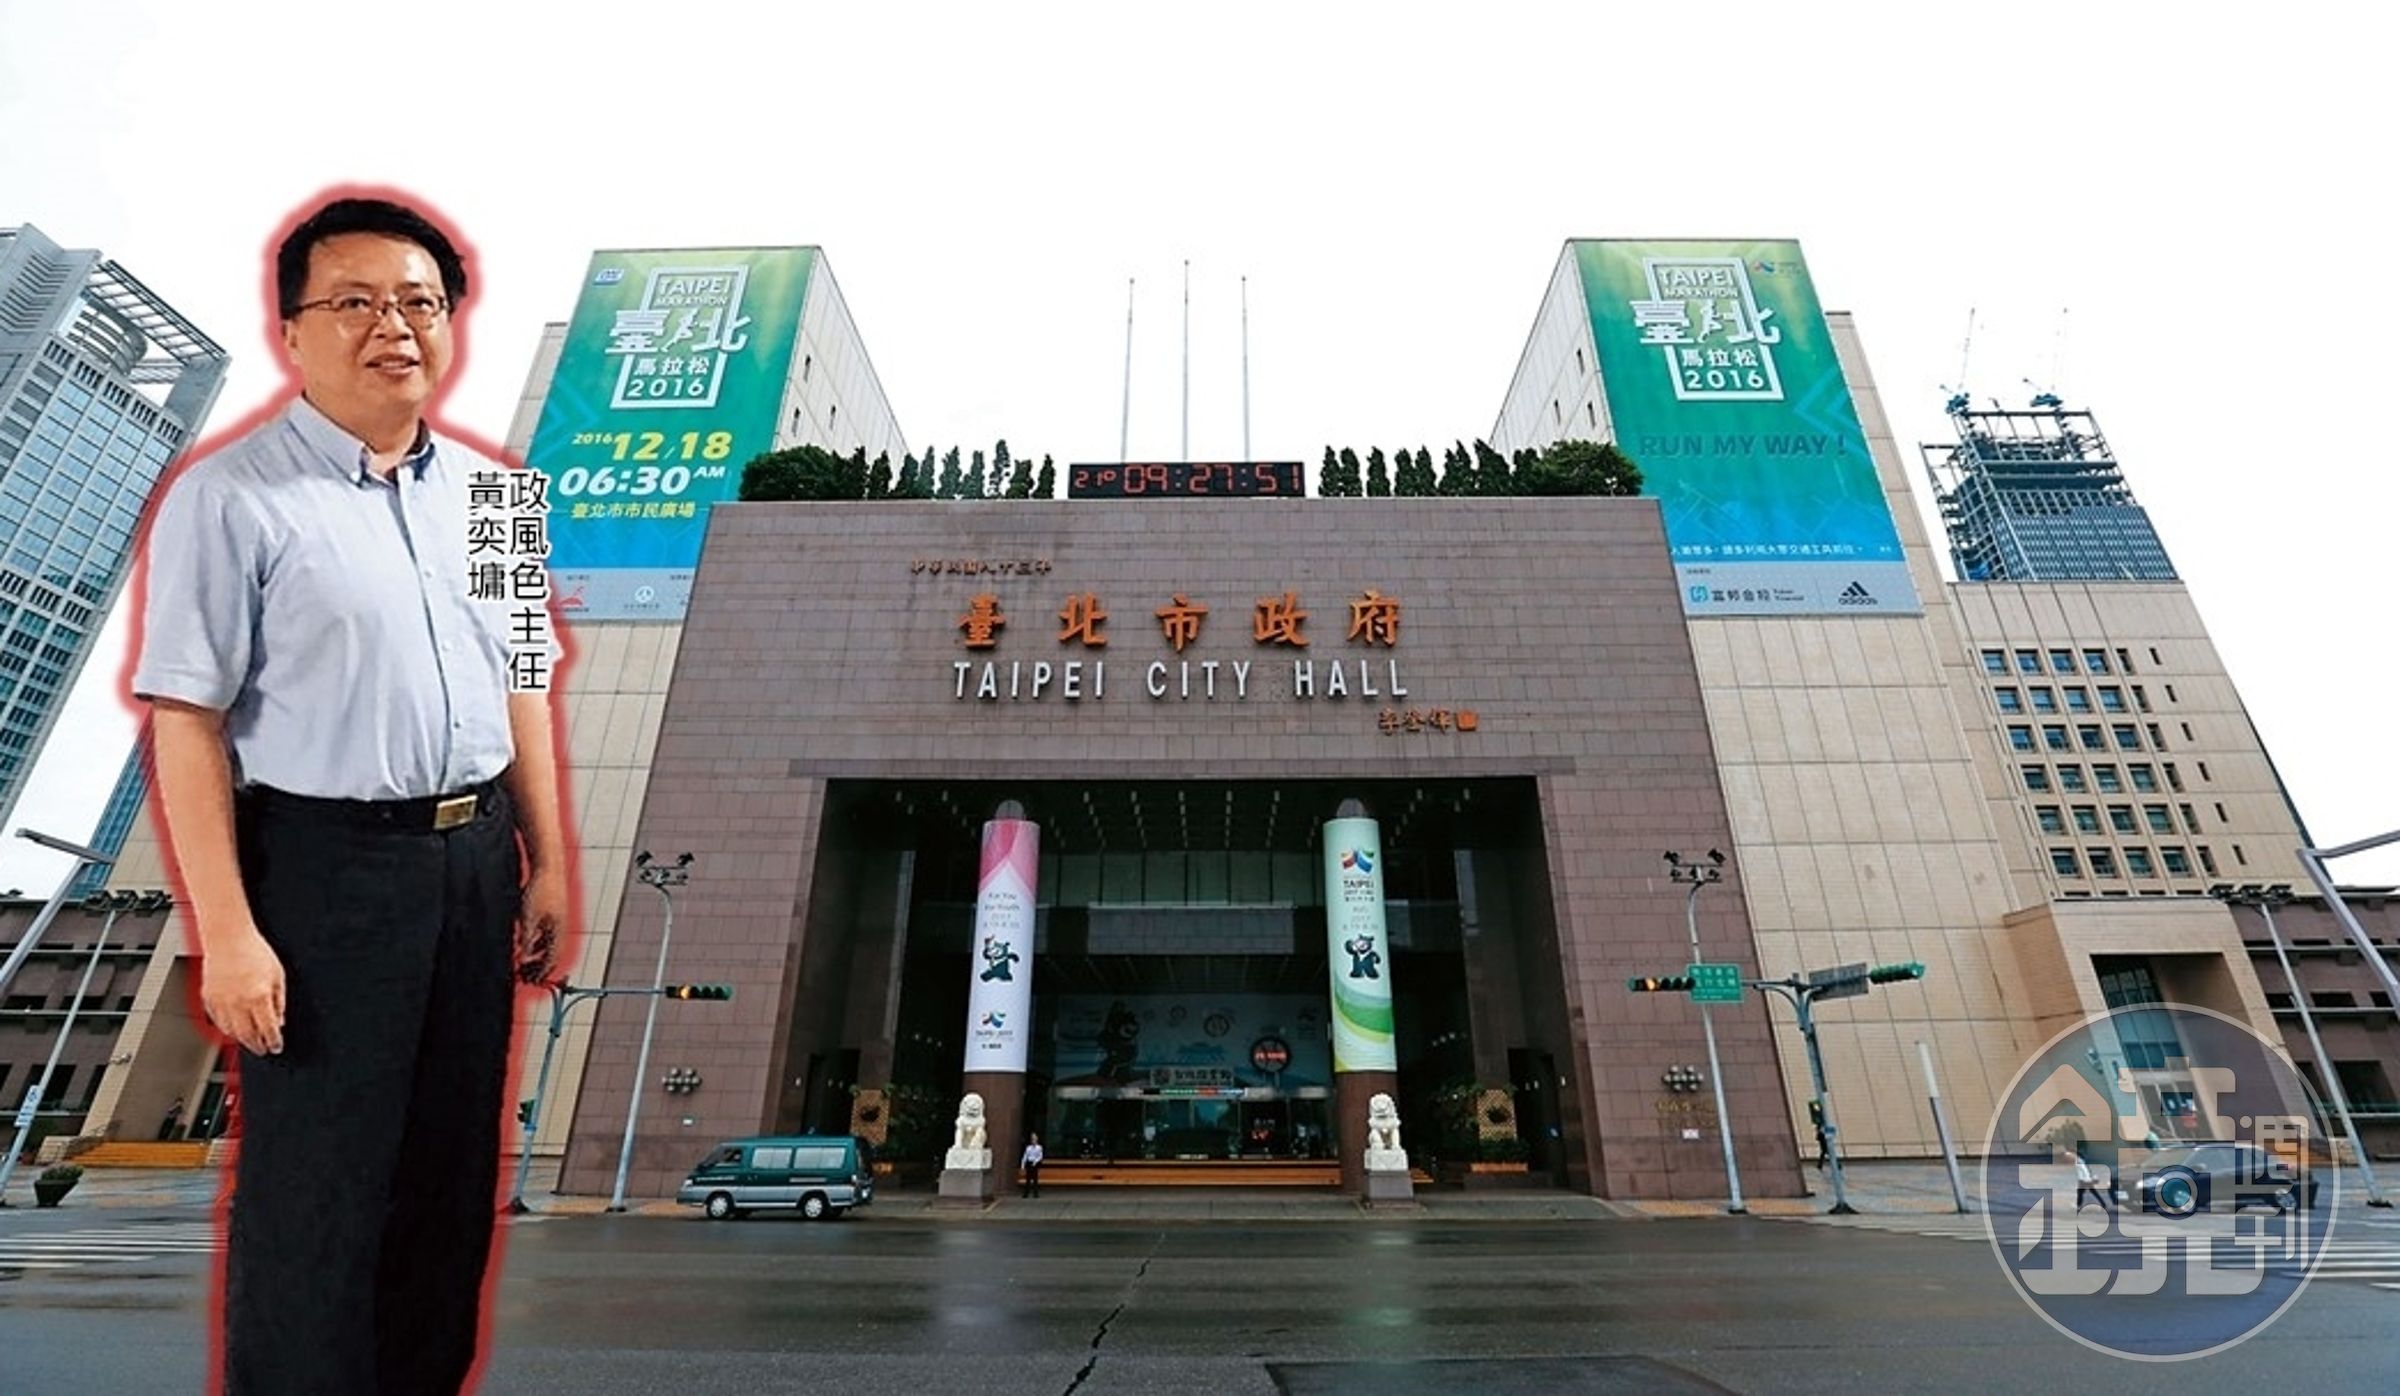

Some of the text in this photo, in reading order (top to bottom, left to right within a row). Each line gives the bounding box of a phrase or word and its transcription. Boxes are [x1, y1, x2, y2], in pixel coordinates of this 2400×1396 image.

[658, 276, 732, 296] TAIPEI
[1659, 267, 1735, 288] TAIPEI
[633, 356, 710, 376] 馬拉松
[1681, 348, 1759, 367] 馬拉松
[626, 378, 705, 398] 2016
[1684, 369, 1764, 390] 2016
[571, 431, 733, 462] 2016 12/18
[1639, 434, 1702, 456] RUN
[1713, 434, 1757, 456] MY
[1764, 434, 1828, 456] WAY
[558, 465, 726, 496] 06:30 AM
[1838, 597, 1879, 606] adidas
[958, 590, 1404, 652] 臺北市政府
[953, 659, 1409, 699] TAIPEI CITY HALL
